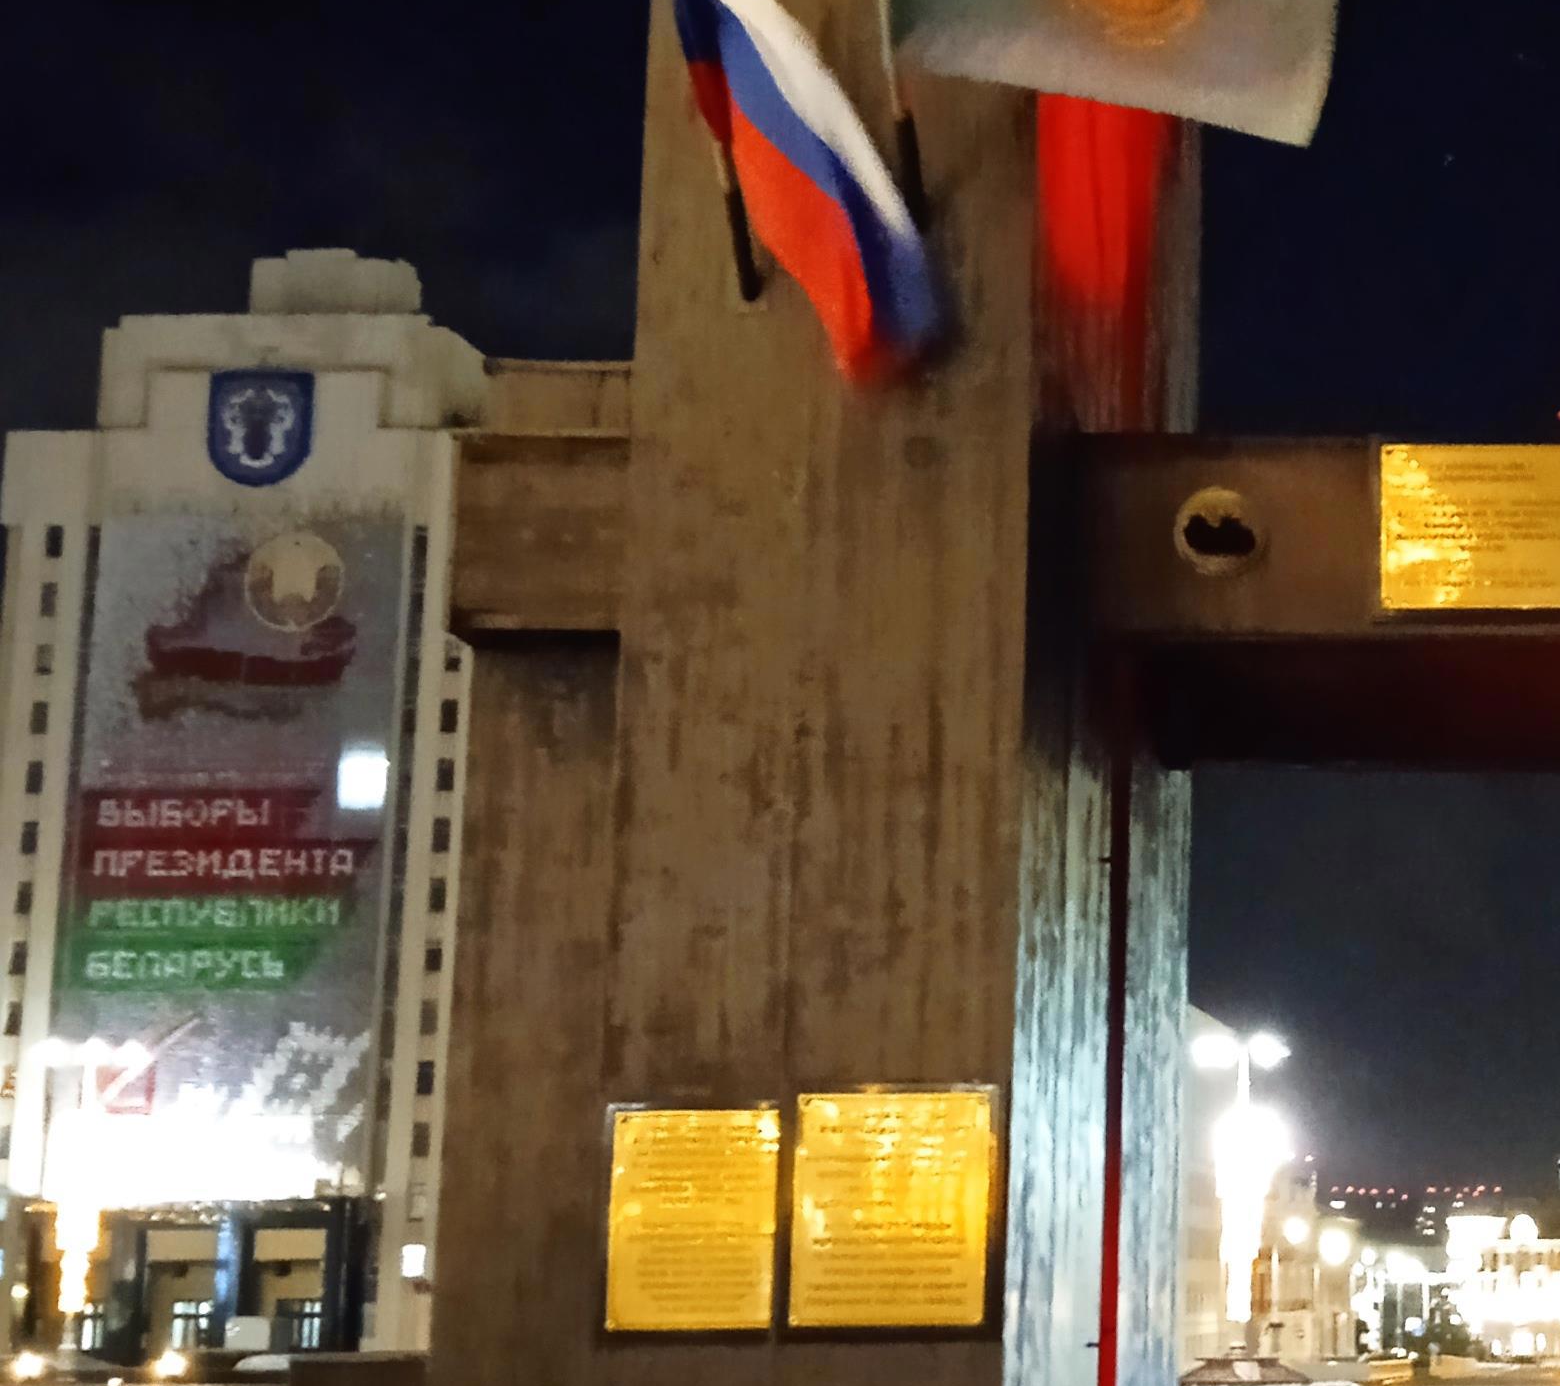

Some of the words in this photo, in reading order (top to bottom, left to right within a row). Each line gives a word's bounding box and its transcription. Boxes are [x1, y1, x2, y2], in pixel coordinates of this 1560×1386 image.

[97, 798, 272, 828] ВЫБОРЫ
[93, 848, 354, 880] ПРЕЗИДЕНТА
[85, 950, 284, 980] БЕЛАРУСЬ
